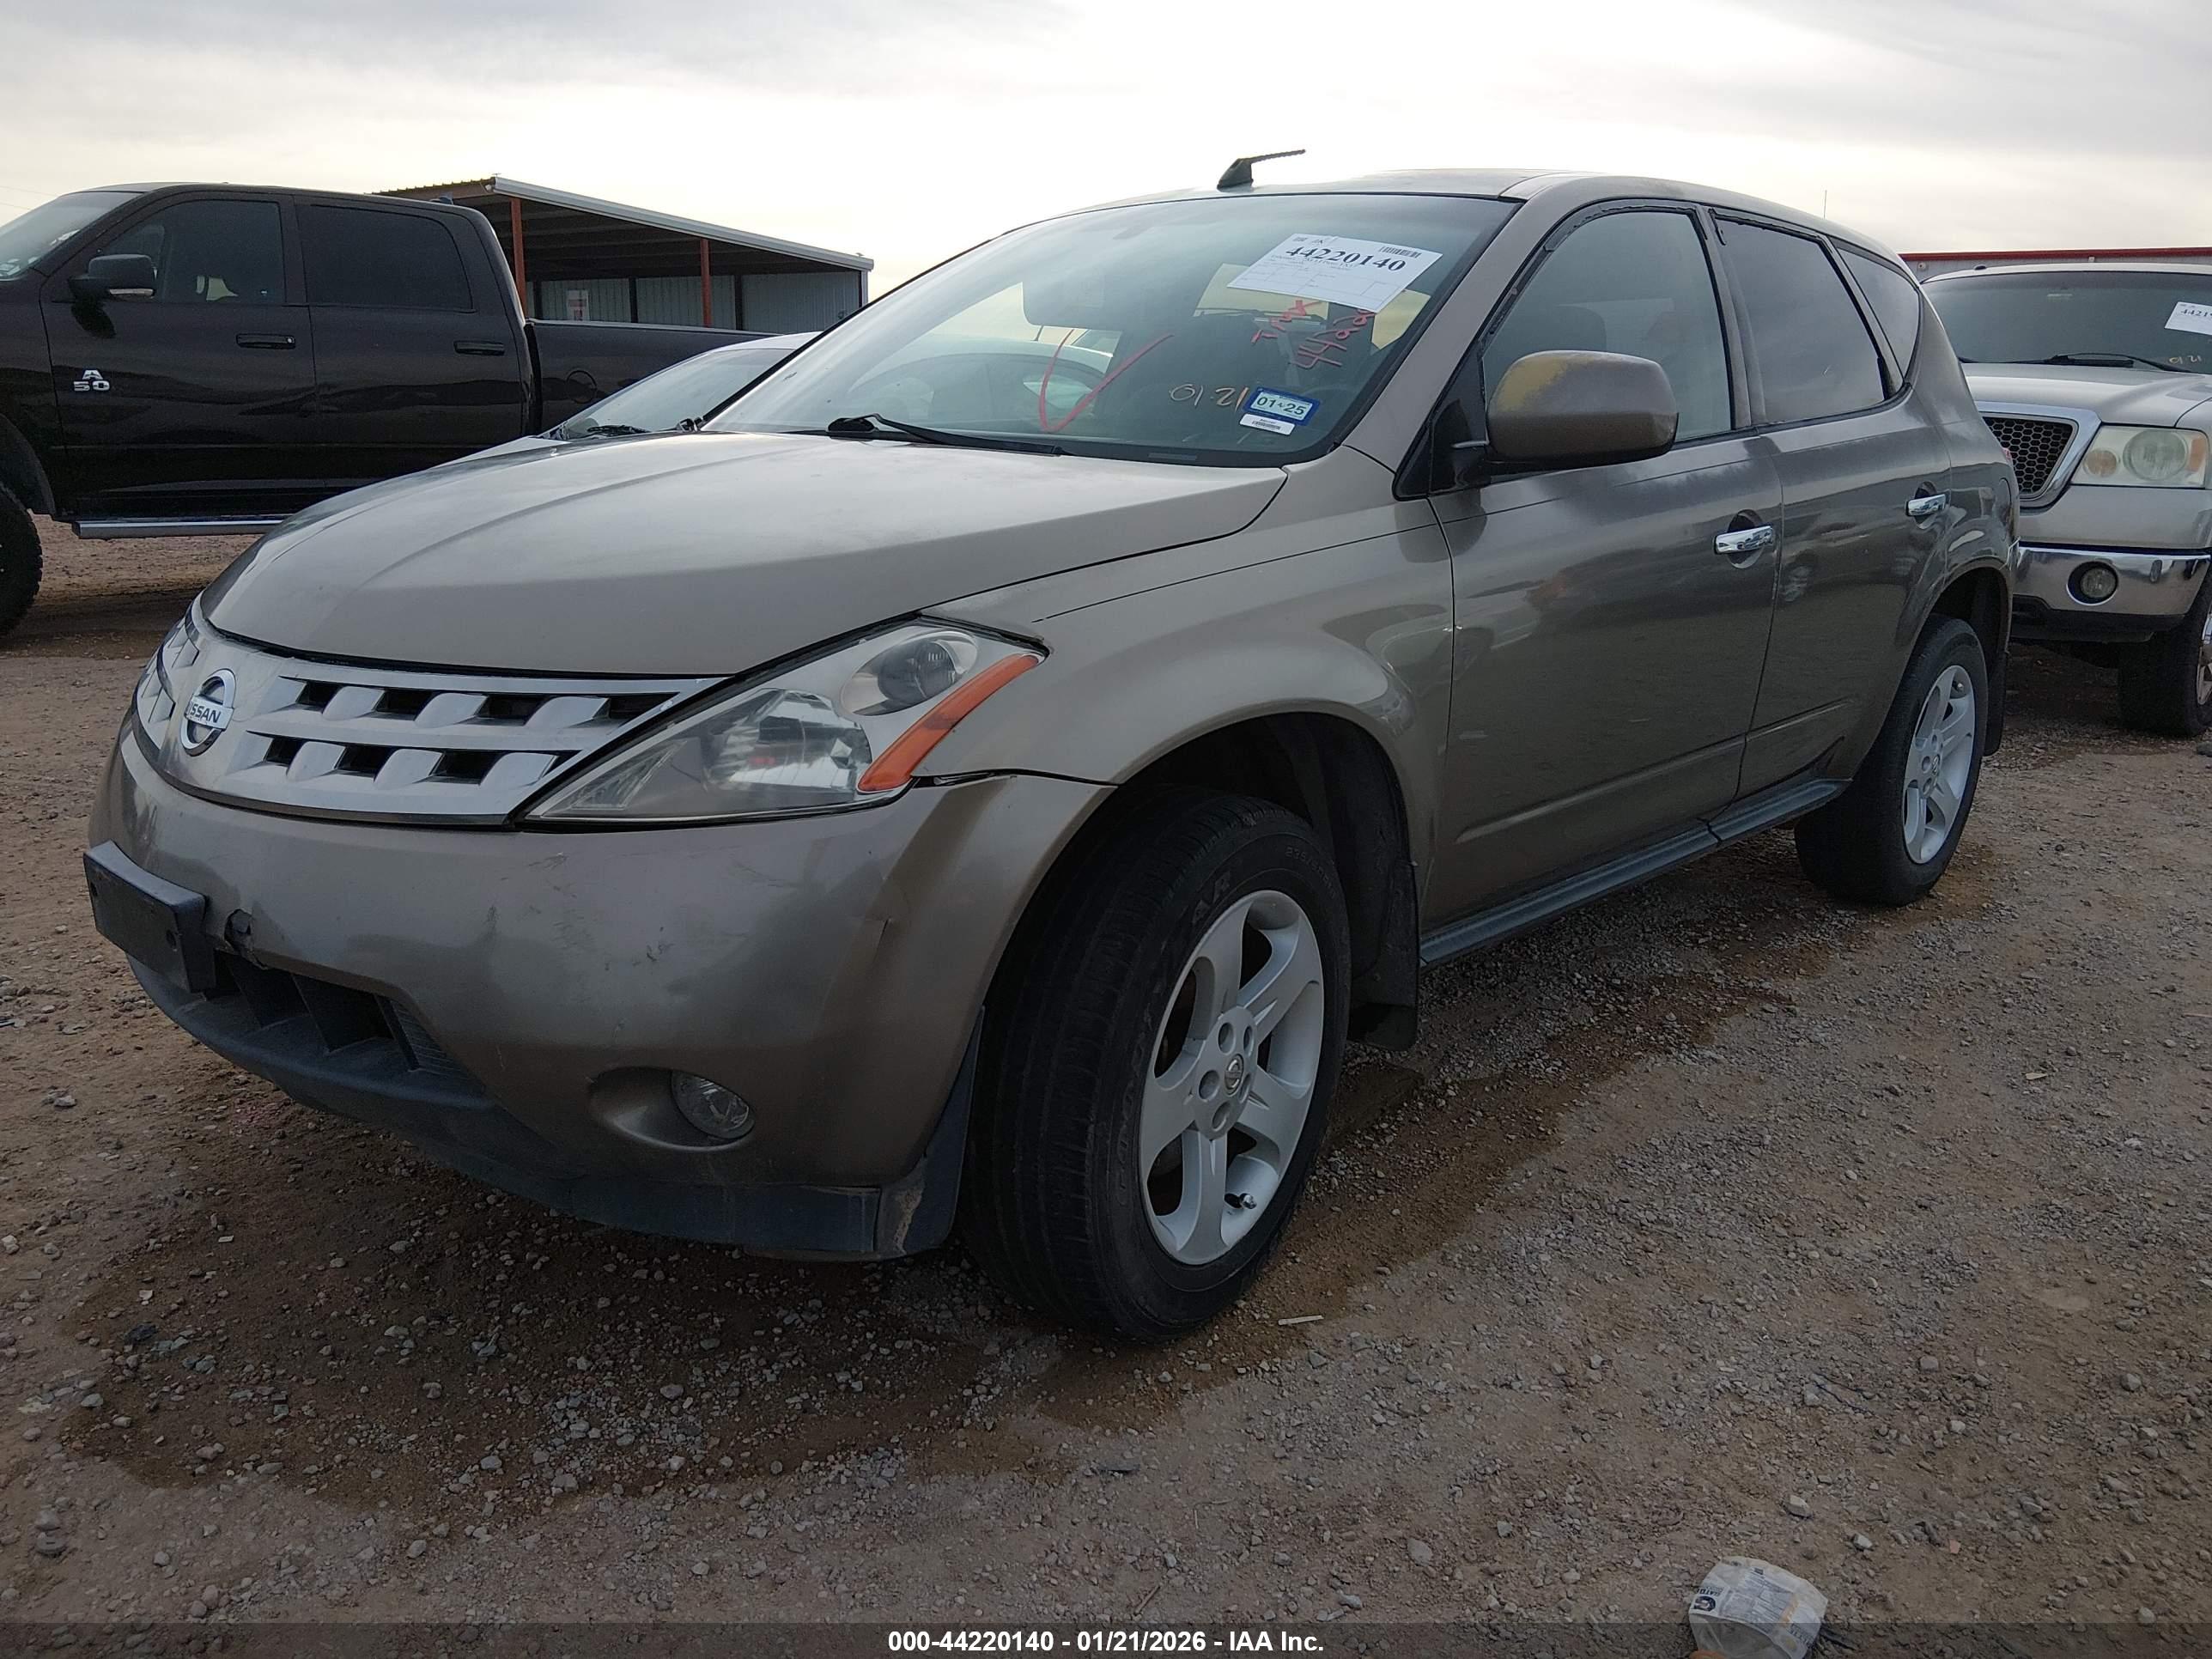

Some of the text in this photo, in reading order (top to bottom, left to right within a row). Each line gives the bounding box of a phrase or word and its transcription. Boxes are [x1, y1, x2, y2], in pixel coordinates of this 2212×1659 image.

[1286, 246, 1406, 271] 44220140
[74, 380, 110, 392] 50
[1256, 396, 1276, 408] 01
[1283, 404, 1308, 416] 25
